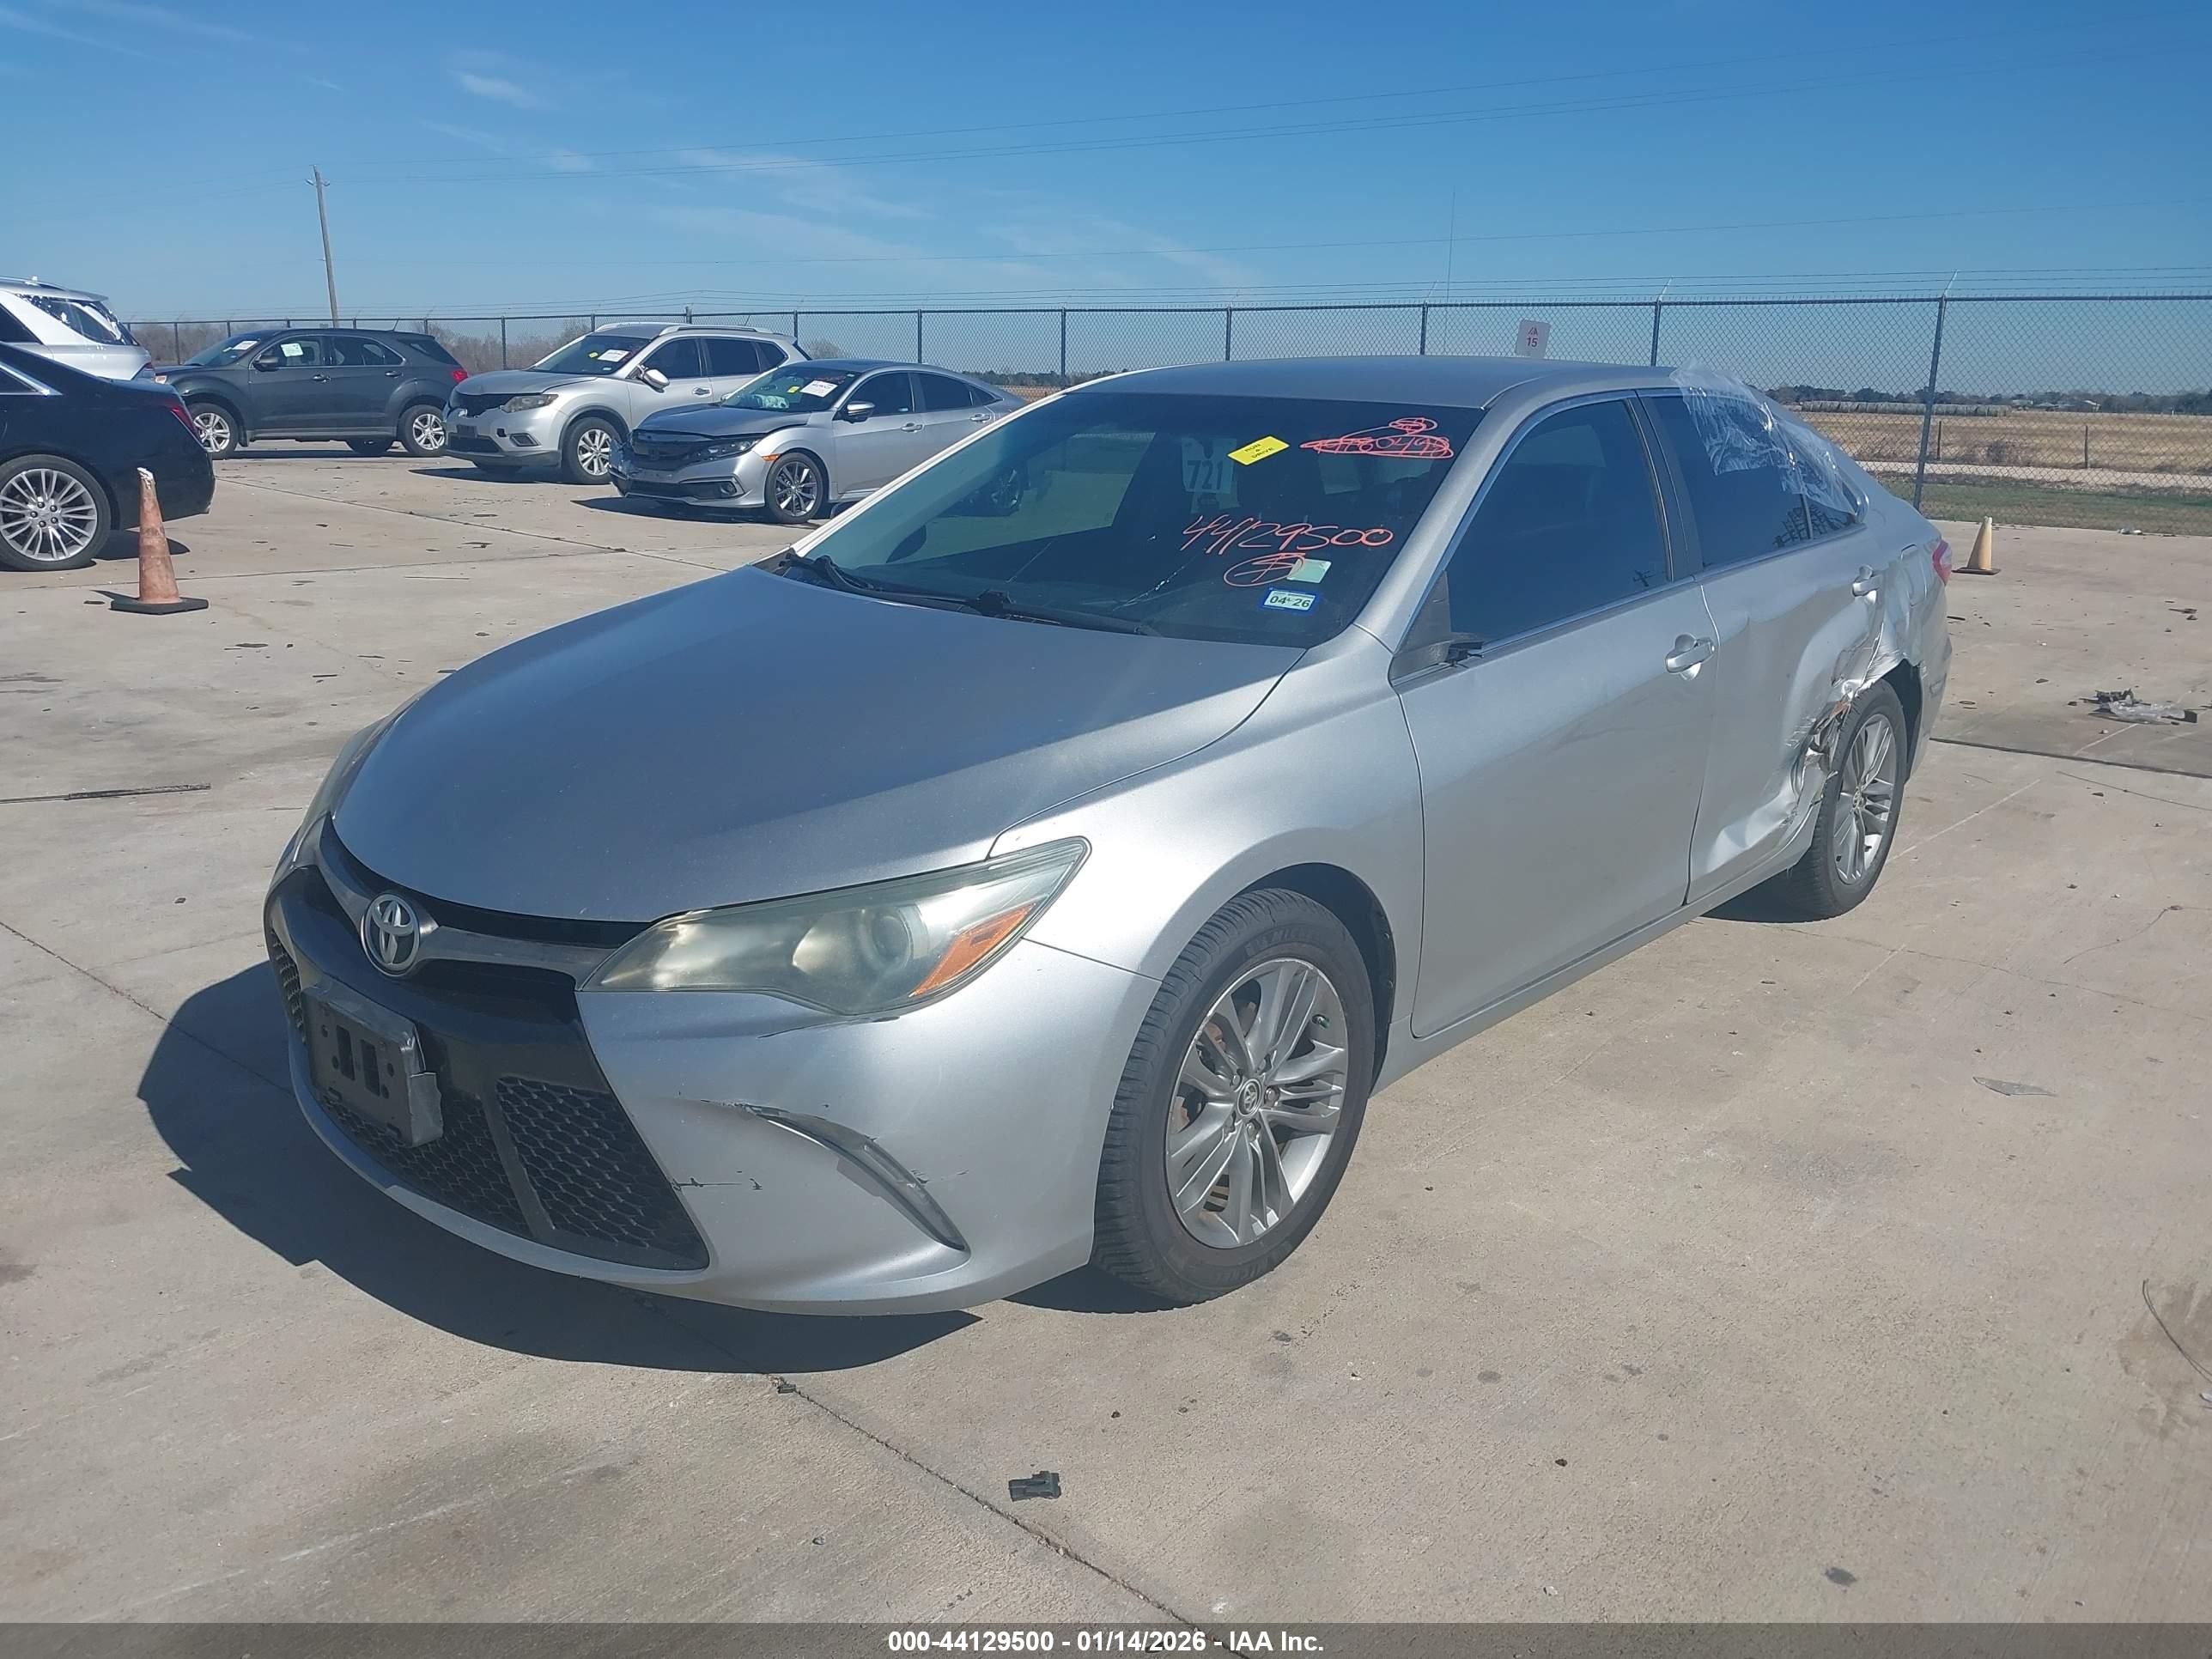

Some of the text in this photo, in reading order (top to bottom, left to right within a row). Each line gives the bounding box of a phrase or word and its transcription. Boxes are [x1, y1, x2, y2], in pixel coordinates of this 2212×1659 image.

[1526, 337, 1538, 348] 15
[1251, 447, 1274, 459] DRIVE
[1187, 459, 1224, 490] 721
[1179, 514, 1394, 555] 44129500
[1269, 595, 1287, 605] 04
[1291, 598, 1311, 608] 26
